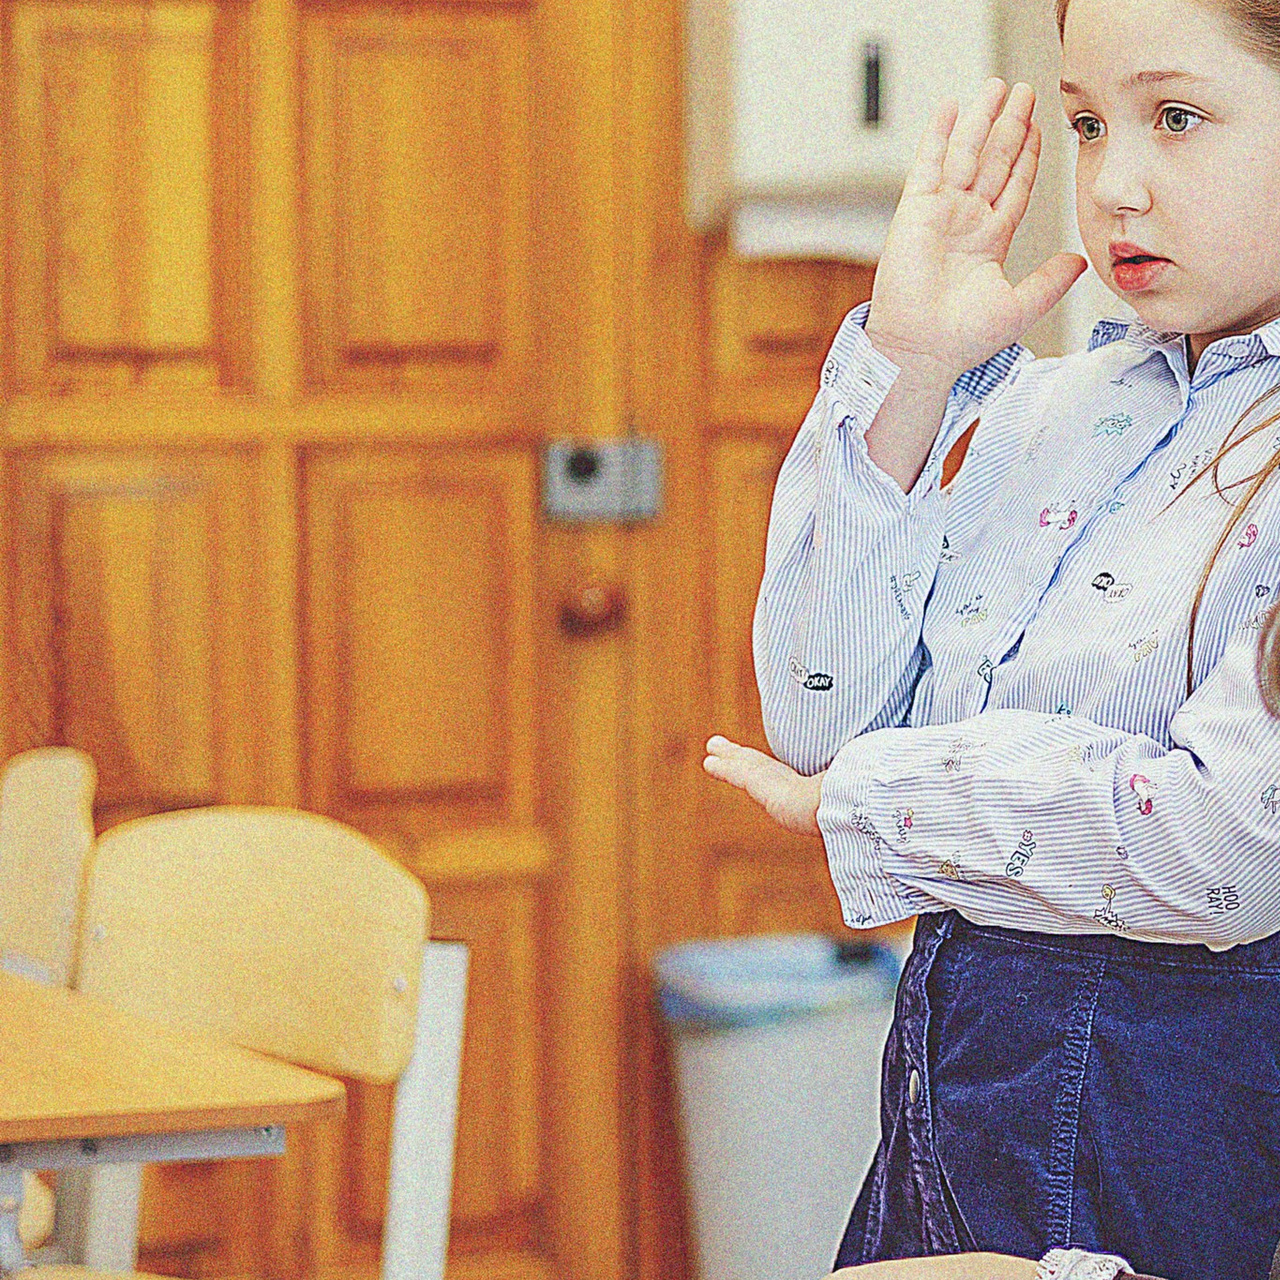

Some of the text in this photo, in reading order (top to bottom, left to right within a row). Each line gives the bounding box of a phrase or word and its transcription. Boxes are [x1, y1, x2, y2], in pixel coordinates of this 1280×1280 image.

[806, 676, 832, 688] OKAY
[1206, 887, 1225, 916] RAY!
[1221, 885, 1241, 911] HOO
